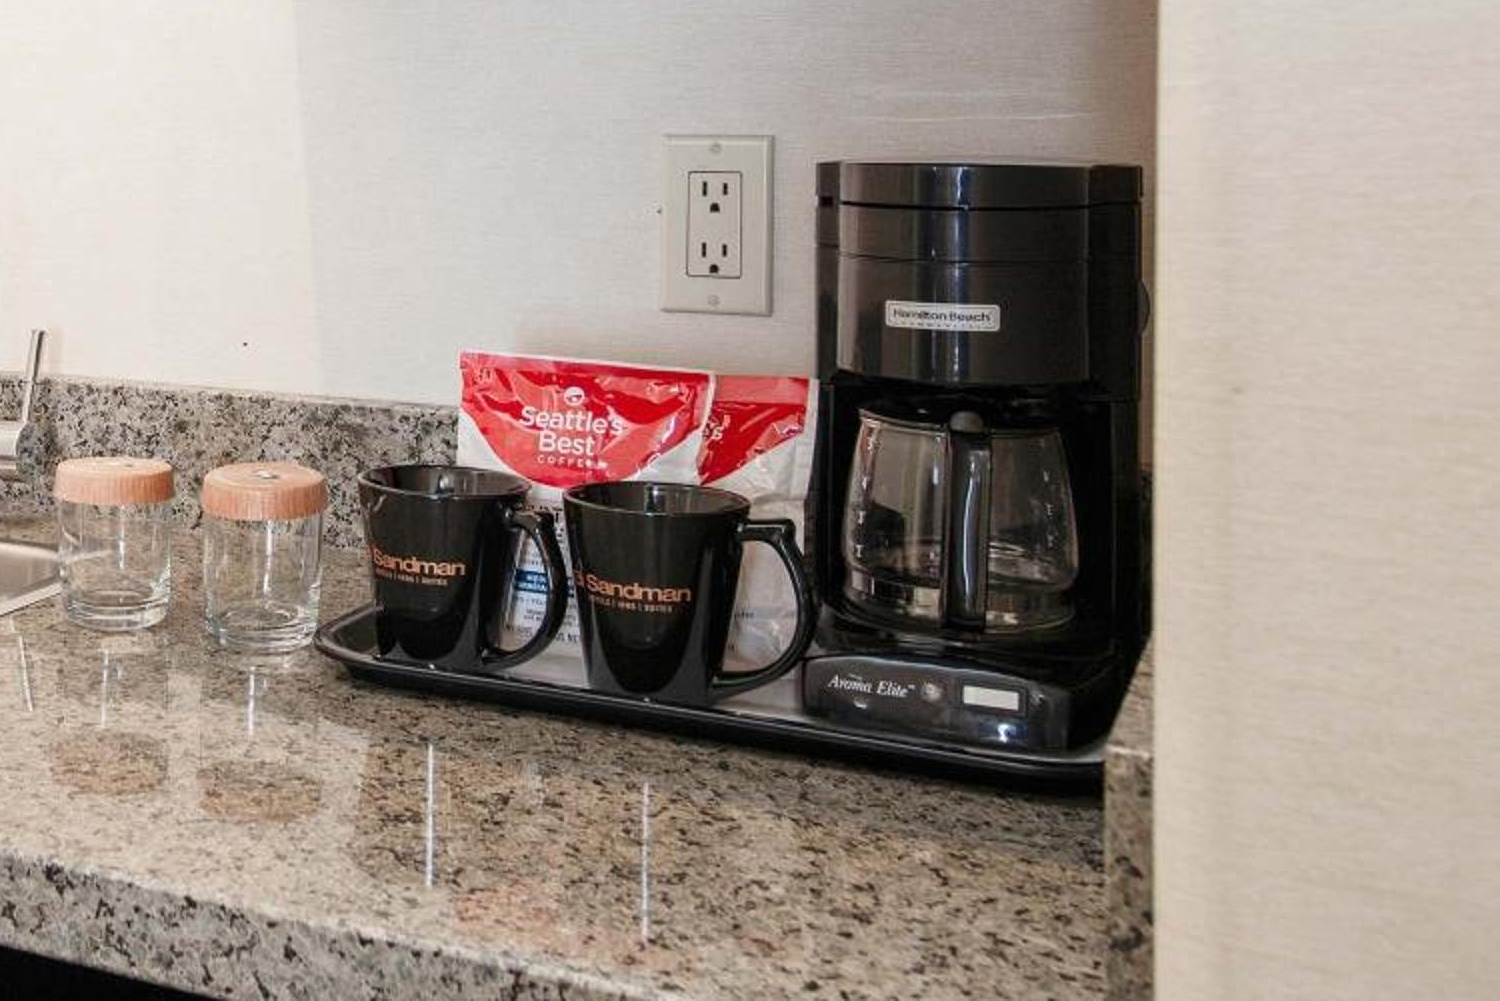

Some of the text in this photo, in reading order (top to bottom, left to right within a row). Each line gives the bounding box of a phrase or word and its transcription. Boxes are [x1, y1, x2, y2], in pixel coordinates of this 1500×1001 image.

[893, 308, 992, 322] Hamilton Beach
[517, 406, 629, 437] Seattle's
[538, 432, 597, 457] Best
[373, 548, 467, 576] Sandman
[585, 574, 693, 603] Sandman
[826, 674, 910, 699] Aroma Elite
